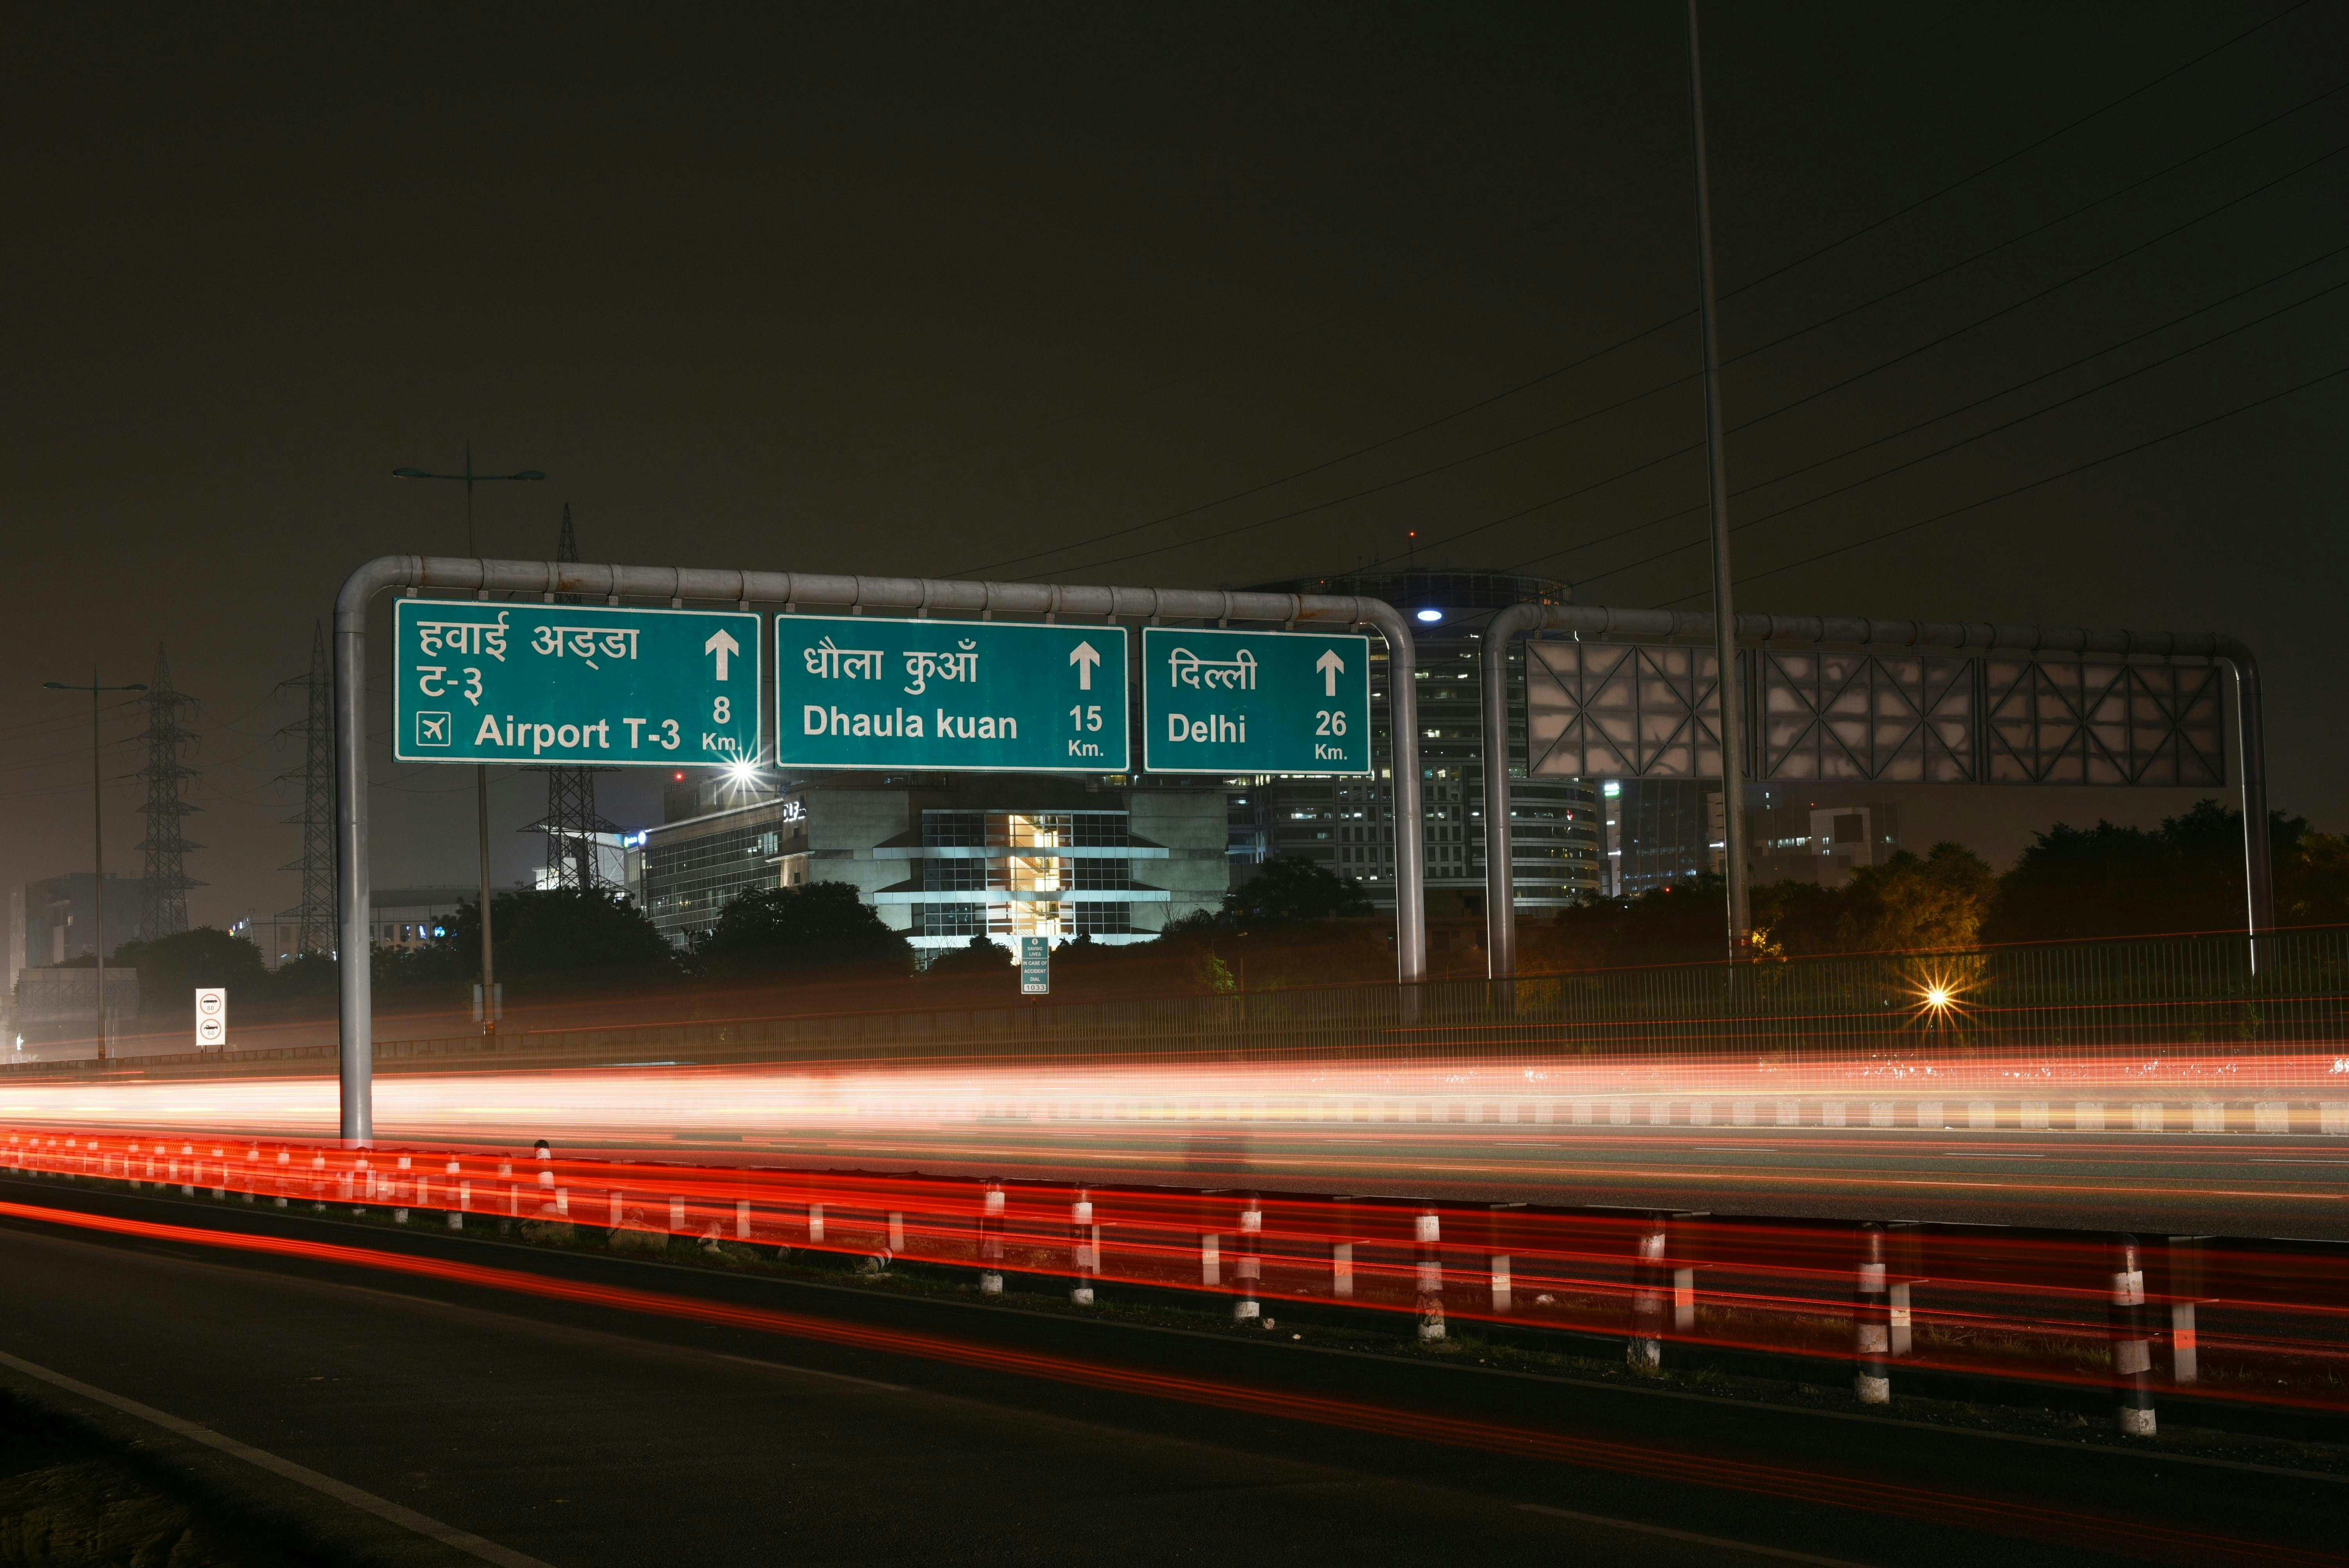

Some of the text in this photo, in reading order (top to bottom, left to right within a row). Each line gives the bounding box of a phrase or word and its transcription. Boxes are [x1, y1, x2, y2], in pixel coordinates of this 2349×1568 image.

[417, 611, 640, 670] हवाई अड्डा
[804, 636, 978, 695] धौला कुआँ
[1168, 648, 1257, 689] दिल्ली
[417, 666, 482, 706] ट-३
[713, 697, 730, 723] 8
[804, 706, 1016, 738] Dhaula kuan
[1070, 706, 1102, 731] 15
[1316, 711, 1346, 736] 26
[475, 715, 680, 754] Airport T-3
[703, 733, 742, 750] Km.
[1169, 714, 1245, 742] Delhi
[1069, 740, 1103, 756] Km.
[1315, 744, 1347, 759] Km.
